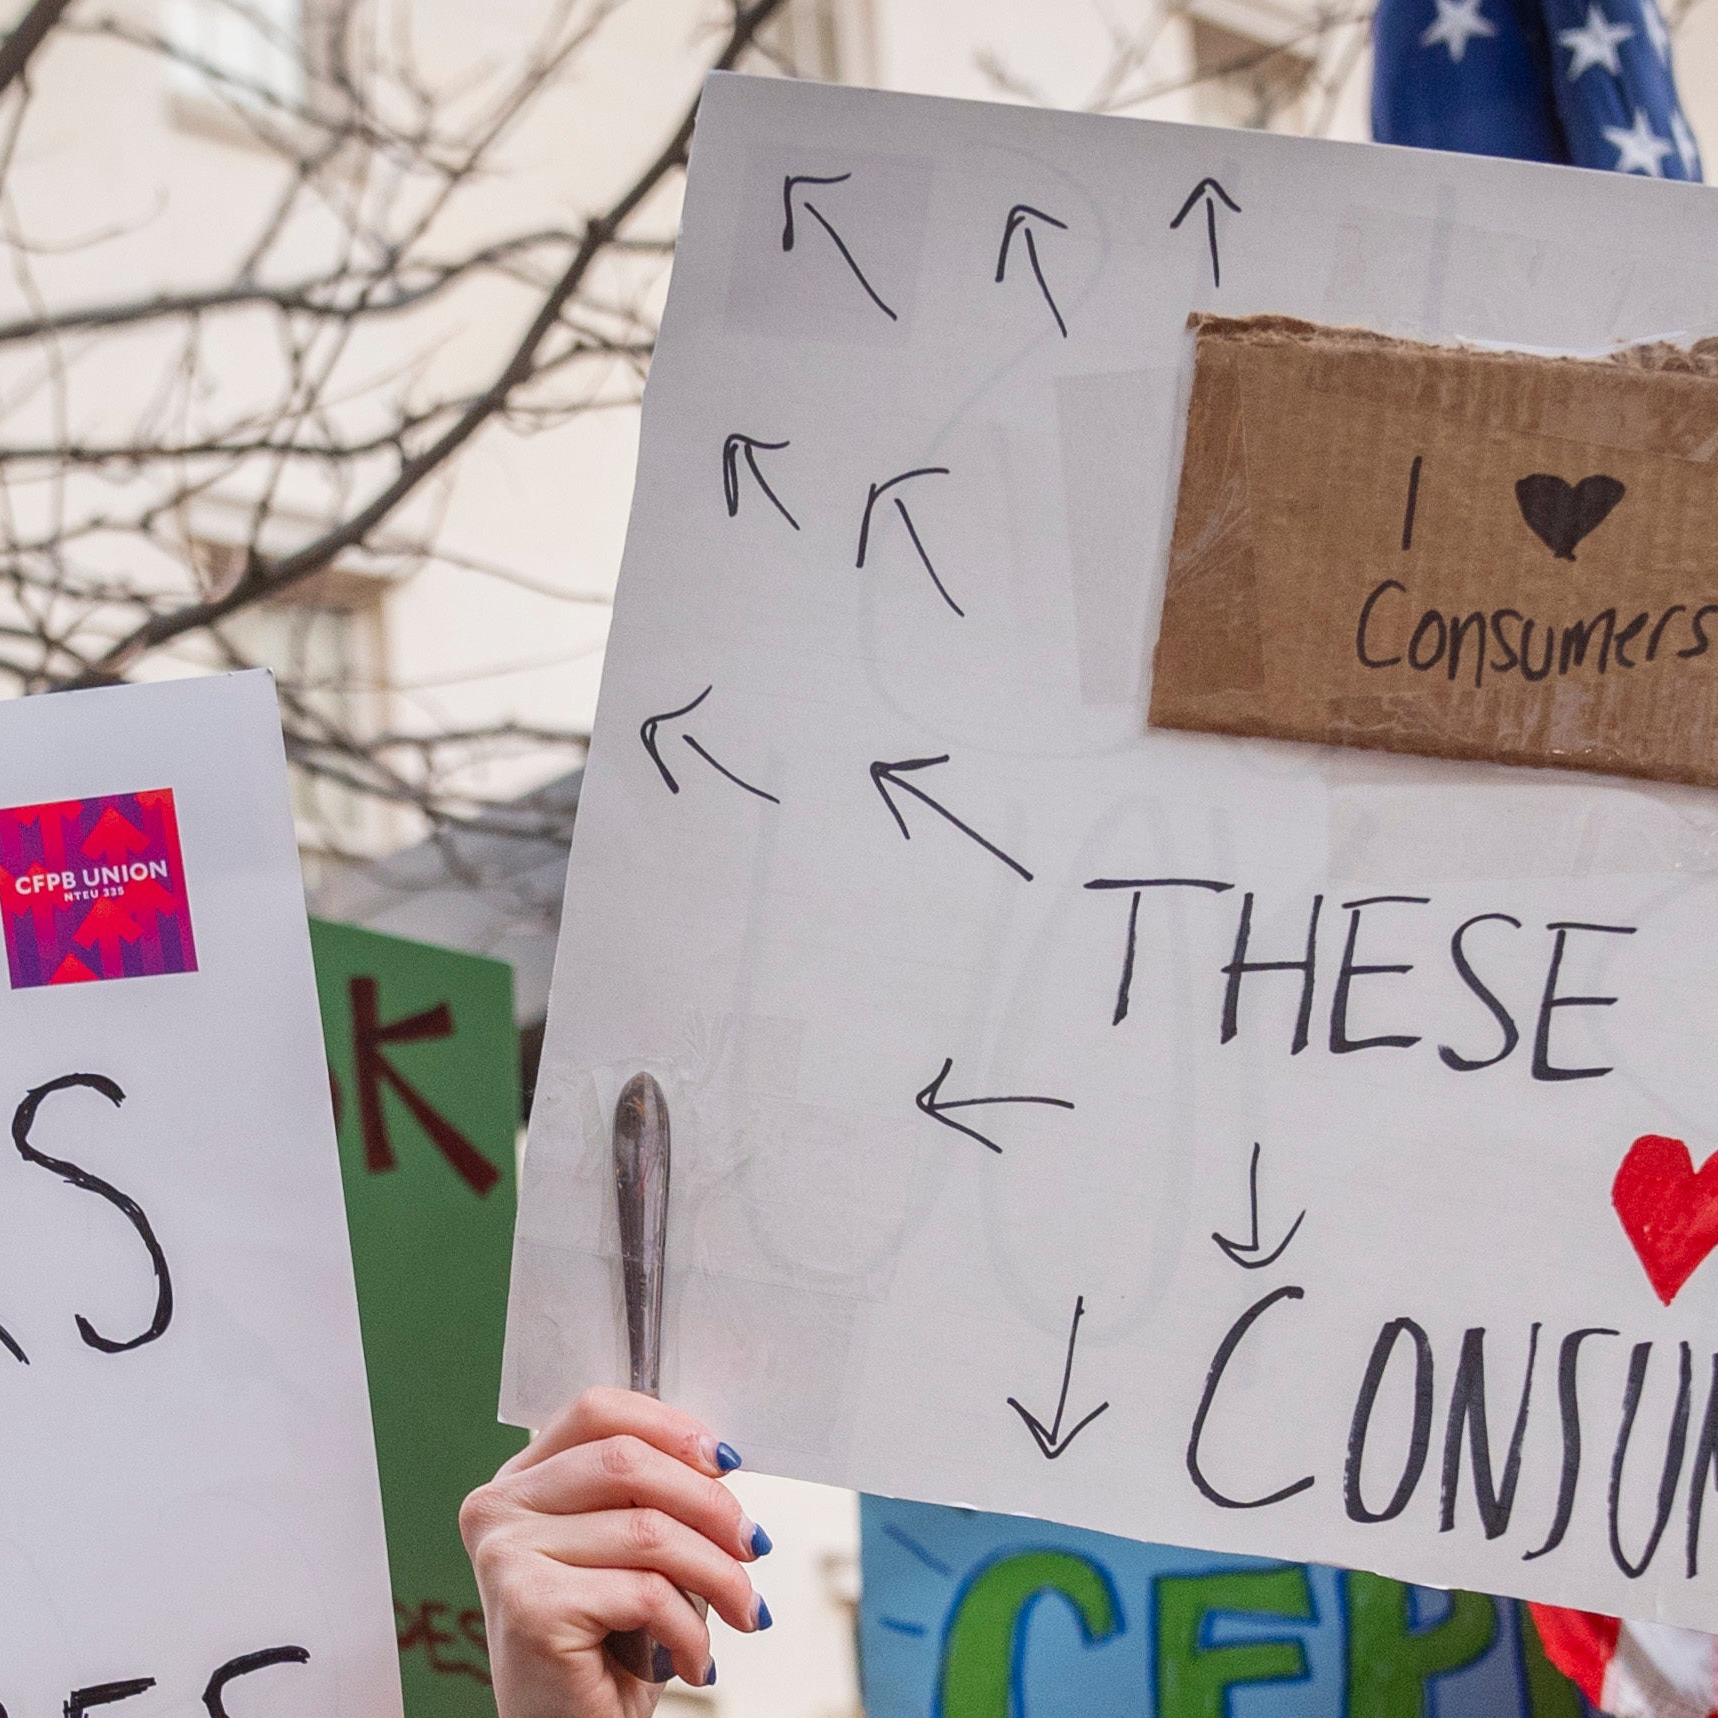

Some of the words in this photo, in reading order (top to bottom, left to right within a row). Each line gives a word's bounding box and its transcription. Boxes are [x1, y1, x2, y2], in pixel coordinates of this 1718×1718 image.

[1401, 456, 1422, 550] I
[1355, 578, 1718, 688] Consumers
[15, 871, 77, 895] CFPB
[83, 859, 168, 887] UNION
[64, 889, 99, 902] NTEU
[103, 886, 125, 897] 335
[1084, 877, 1637, 1082] THESE
[328, 976, 502, 1198] K
